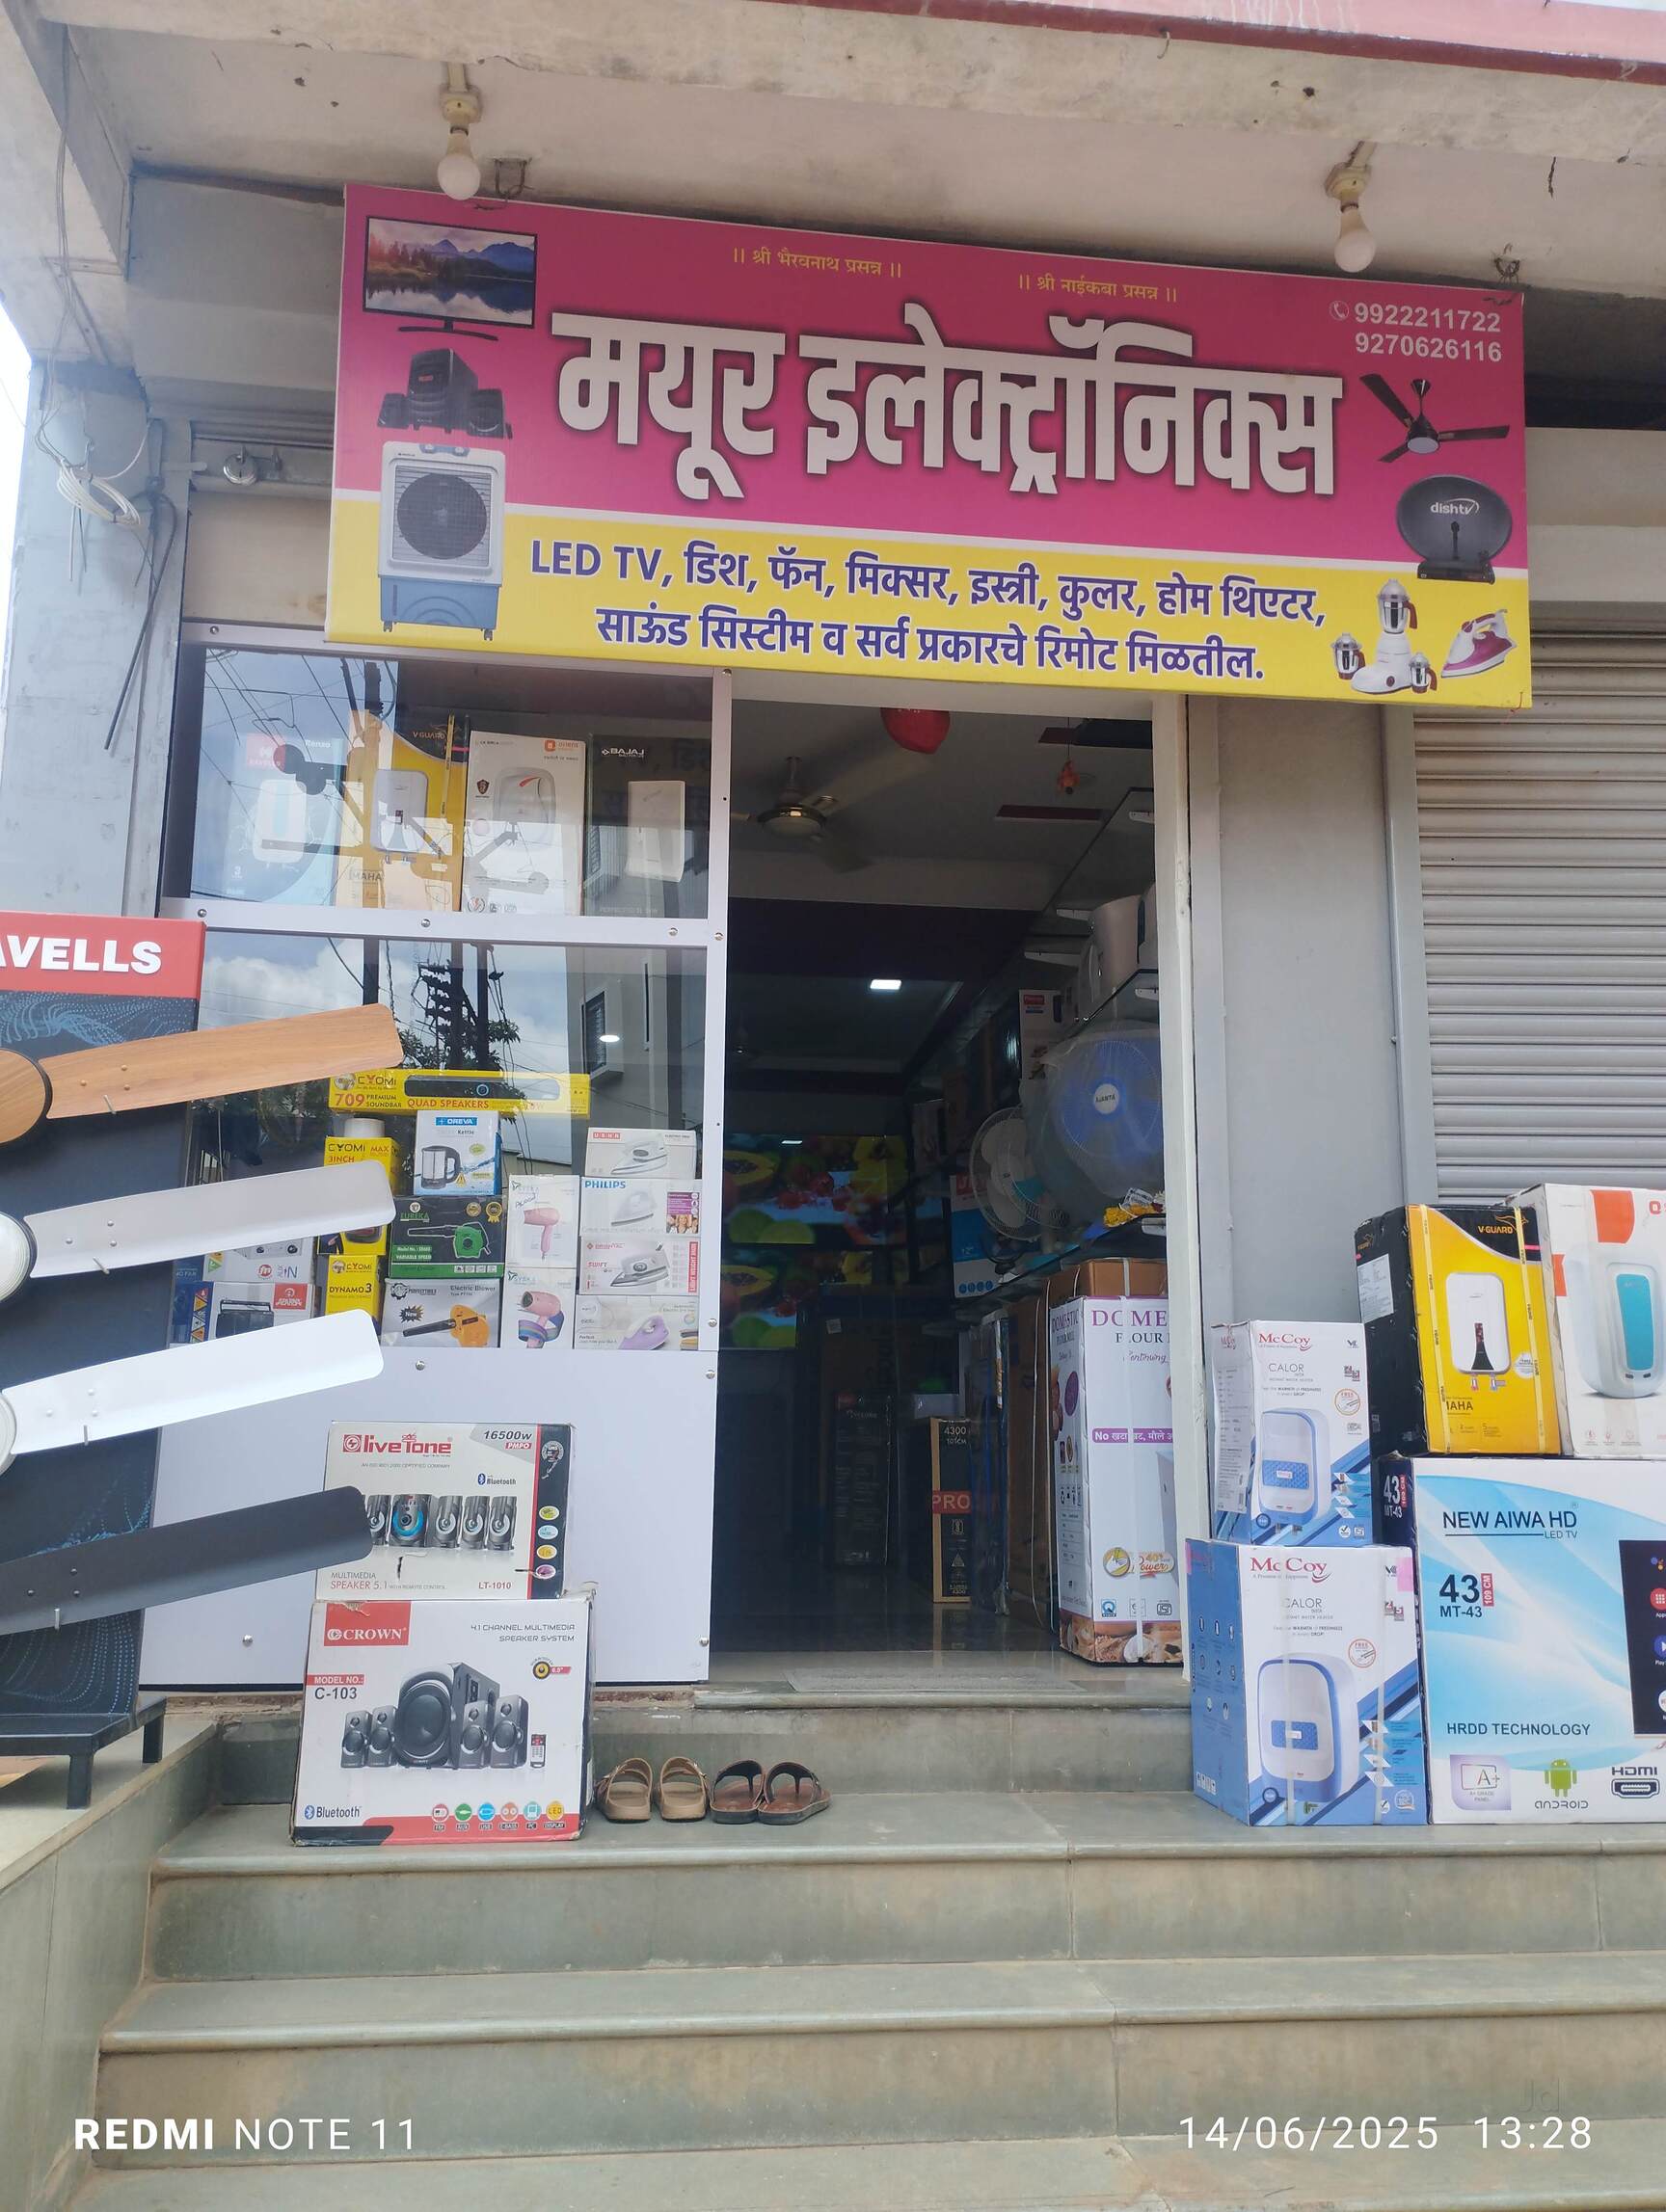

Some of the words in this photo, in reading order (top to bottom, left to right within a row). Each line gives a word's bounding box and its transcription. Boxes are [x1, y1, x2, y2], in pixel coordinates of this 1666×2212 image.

[752, 247, 772, 266] श्री
[777, 250, 840, 273] भैरवनाथ
[845, 257, 882, 278] प्रसन्न
[1036, 273, 1056, 292] श्री
[1122, 281, 1159, 302] प्रसन्न
[1354, 302, 1501, 333] 9922211722
[1355, 332, 1502, 362] 9270626116
[551, 311, 786, 500] मयूर
[798, 302, 1343, 495] इलेक्ट्रॉनिक्स
[531, 540, 601, 576] LED
[614, 546, 673, 588] TV,
[684, 540, 758, 594] डिश,
[768, 546, 836, 599] फॅन,
[846, 550, 959, 606] मिक्सर,
[968, 562, 1048, 612] इस्त्री,
[1058, 574, 1146, 621] कुलर,
[1156, 572, 1213, 616] होम
[1220, 573, 1326, 626] थिएटर,
[596, 601, 691, 648] साऊंड
[699, 603, 813, 655] सिस्टीम
[821, 622, 847, 656] व
[855, 615, 910, 660] सर्व
[916, 623, 1028, 666] प्रकारचे
[1035, 624, 1118, 672] रिमोट
[1126, 629, 1264, 680] मिळतील.
[610, 747, 645, 756] BAJAJ
[0, 933, 162, 974] VELLS
[358, 1075, 396, 1086] CYOMI
[335, 1093, 365, 1107] 709
[407, 1099, 437, 1107] QUAD
[440, 1099, 489, 1109] SPEAKERS
[328, 1143, 365, 1153] CYOMI
[584, 1180, 627, 1189] PHILIPS
[364, 1283, 372, 1293] 3
[1115, 1333, 1164, 1344] FOUR
[1258, 1333, 1310, 1346] McCoy
[1269, 1363, 1304, 1373] CALOR
[484, 1430, 532, 1440] 16500w
[944, 1426, 967, 1435] 4300
[1094, 1431, 1109, 1440] No
[1384, 1475, 1401, 1505] 43
[932, 1495, 971, 1509] PRO
[1384, 1504, 1403, 1518] MT-43
[1443, 1511, 1489, 1529] NEW
[1494, 1511, 1545, 1529] AIWA
[1549, 1510, 1576, 1528] HD
[1250, 1558, 1327, 1575] McCoy
[331, 1581, 371, 1589] SPEAKER
[1439, 1574, 1480, 1603] 43
[1483, 1575, 1491, 1588] CM
[1439, 1606, 1483, 1618] MT-43
[343, 1629, 402, 1640] CROWN
[346, 1676, 364, 1685] NO.:
[314, 1687, 358, 1699] C-103
[1447, 1723, 1488, 1735] HRDD
[1494, 1723, 1591, 1736] TECHNOLOGY
[1612, 1767, 1657, 1776] HDMI
[316, 1805, 361, 1818] Bluetooth
